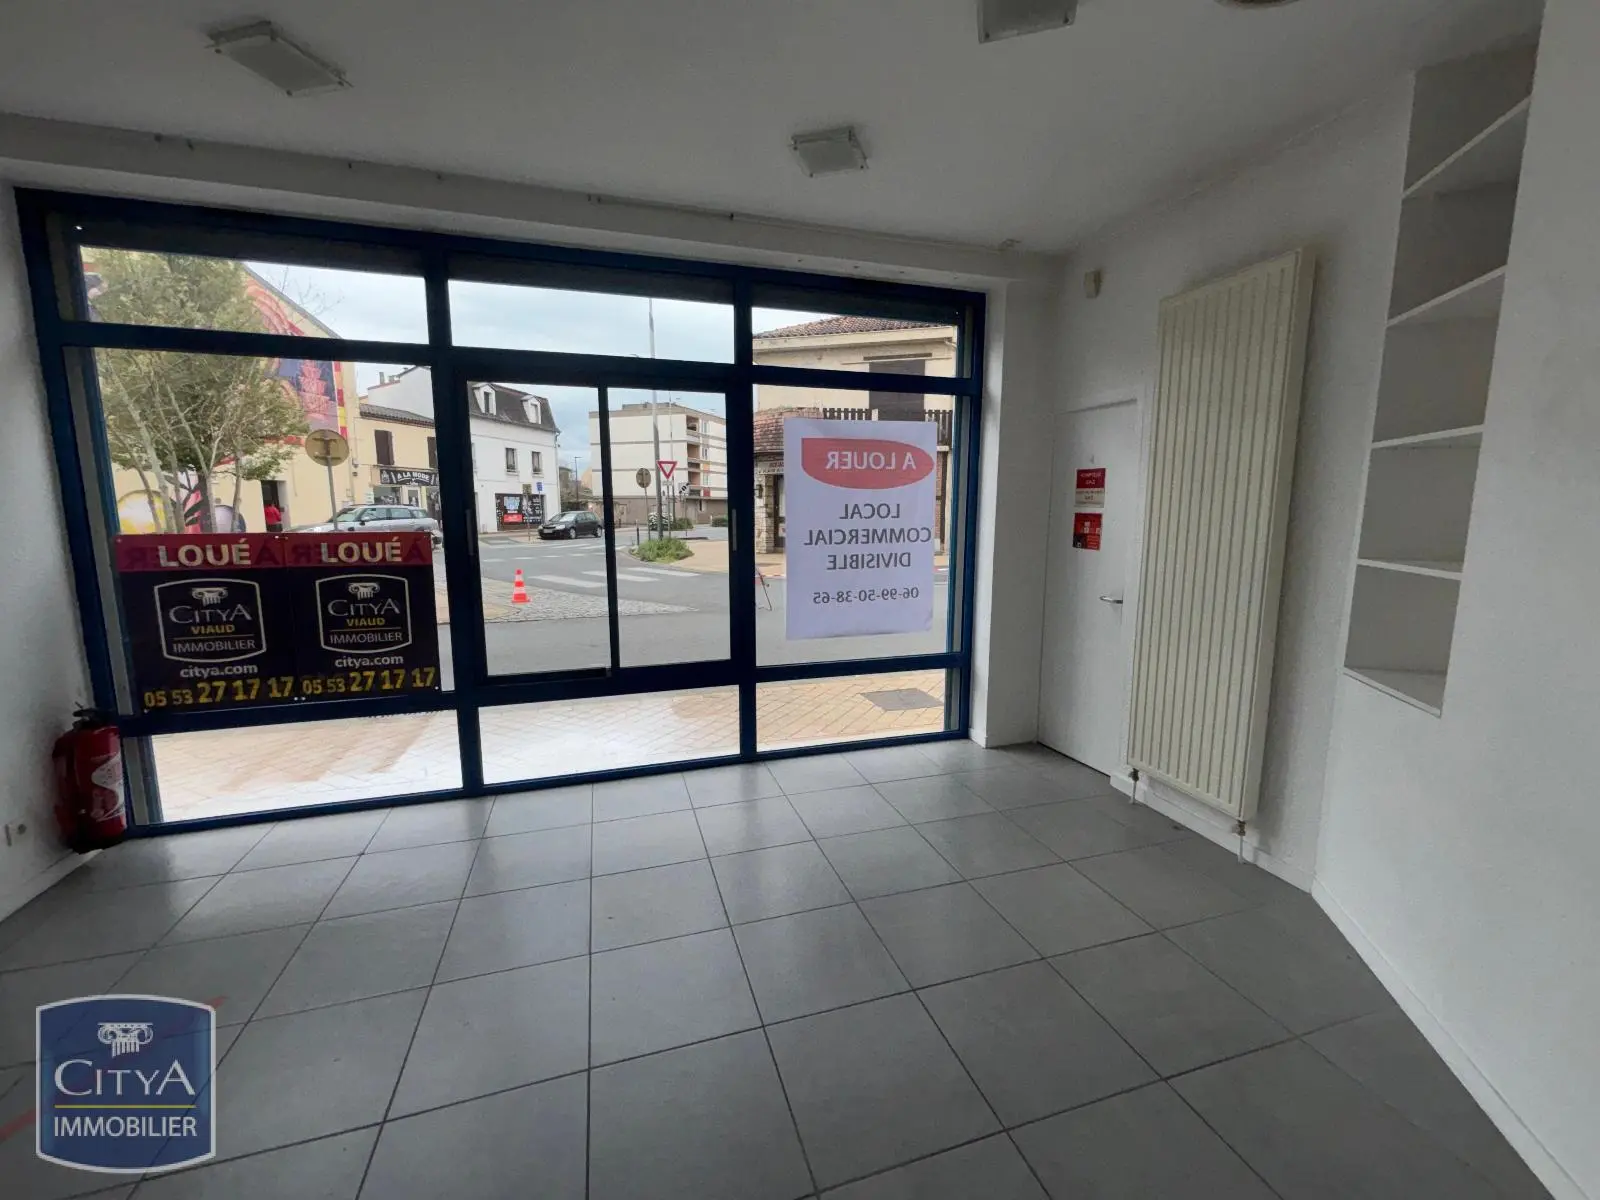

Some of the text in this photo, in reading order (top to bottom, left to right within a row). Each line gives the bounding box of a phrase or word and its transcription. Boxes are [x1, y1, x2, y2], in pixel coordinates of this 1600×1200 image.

[158, 538, 252, 567] LOUÉ
[321, 537, 402, 564] LOUÉ
[168, 603, 252, 625] CITYA
[328, 598, 400, 617] CITYA
[191, 624, 236, 635] VIAUD
[346, 618, 386, 627] VIAUD
[172, 639, 256, 654] IMMOBILIER
[330, 632, 403, 645] IMMOBILIER
[335, 654, 404, 668] citya.com
[180, 663, 258, 679] citya.com
[302, 667, 436, 695] 05 53 27 17 17
[144, 676, 295, 708] 05 53 27 17 17
